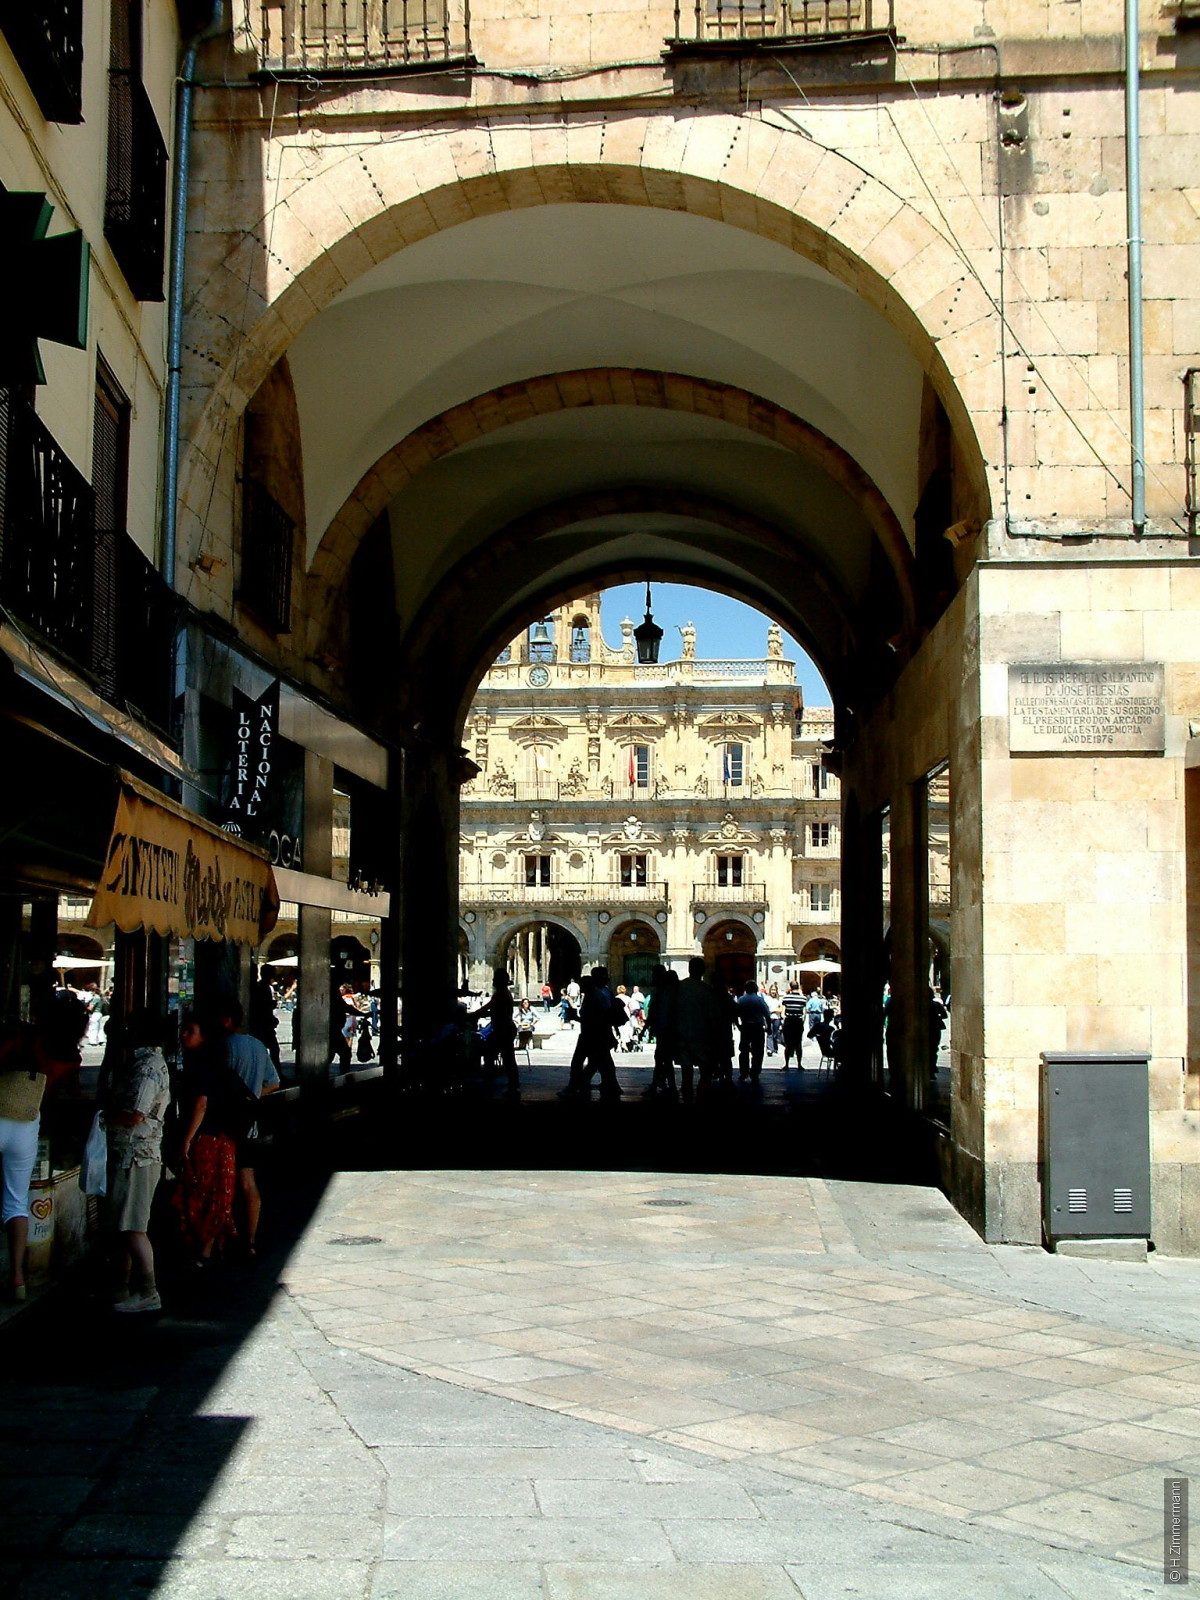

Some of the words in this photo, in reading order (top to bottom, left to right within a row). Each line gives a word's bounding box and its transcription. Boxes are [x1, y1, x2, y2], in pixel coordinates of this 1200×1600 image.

[1021, 673, 1031, 684] EL
[1033, 673, 1071, 684] ILUSTRE
[1102, 672, 1154, 683] SALMANTINO
[1045, 685, 1055, 697] D.
[1086, 684, 1129, 697] IGLESIAS
[1013, 707, 1025, 716] LA
[1027, 706, 1095, 716] TESTAMENTARIA
[1096, 706, 1108, 716] DE
[1110, 706, 1121, 716] SU
[1122, 706, 1160, 716] SOBRINO
[1022, 716, 1034, 725] EL
[1036, 716, 1091, 725] PRESBITERO
[1093, 716, 1111, 725] DON
[1113, 716, 1152, 725] ARCADIO
[1033, 725, 1044, 734] LE
[1046, 725, 1077, 734] DEDICA
[1079, 725, 1100, 734] ESTA
[1101, 725, 1142, 734] MEMORIA
[1062, 733, 1079, 744] AÑO
[1080, 734, 1092, 744] DE
[230, 712, 250, 809] LOTERIA
[247, 705, 272, 816] NACIONAL
